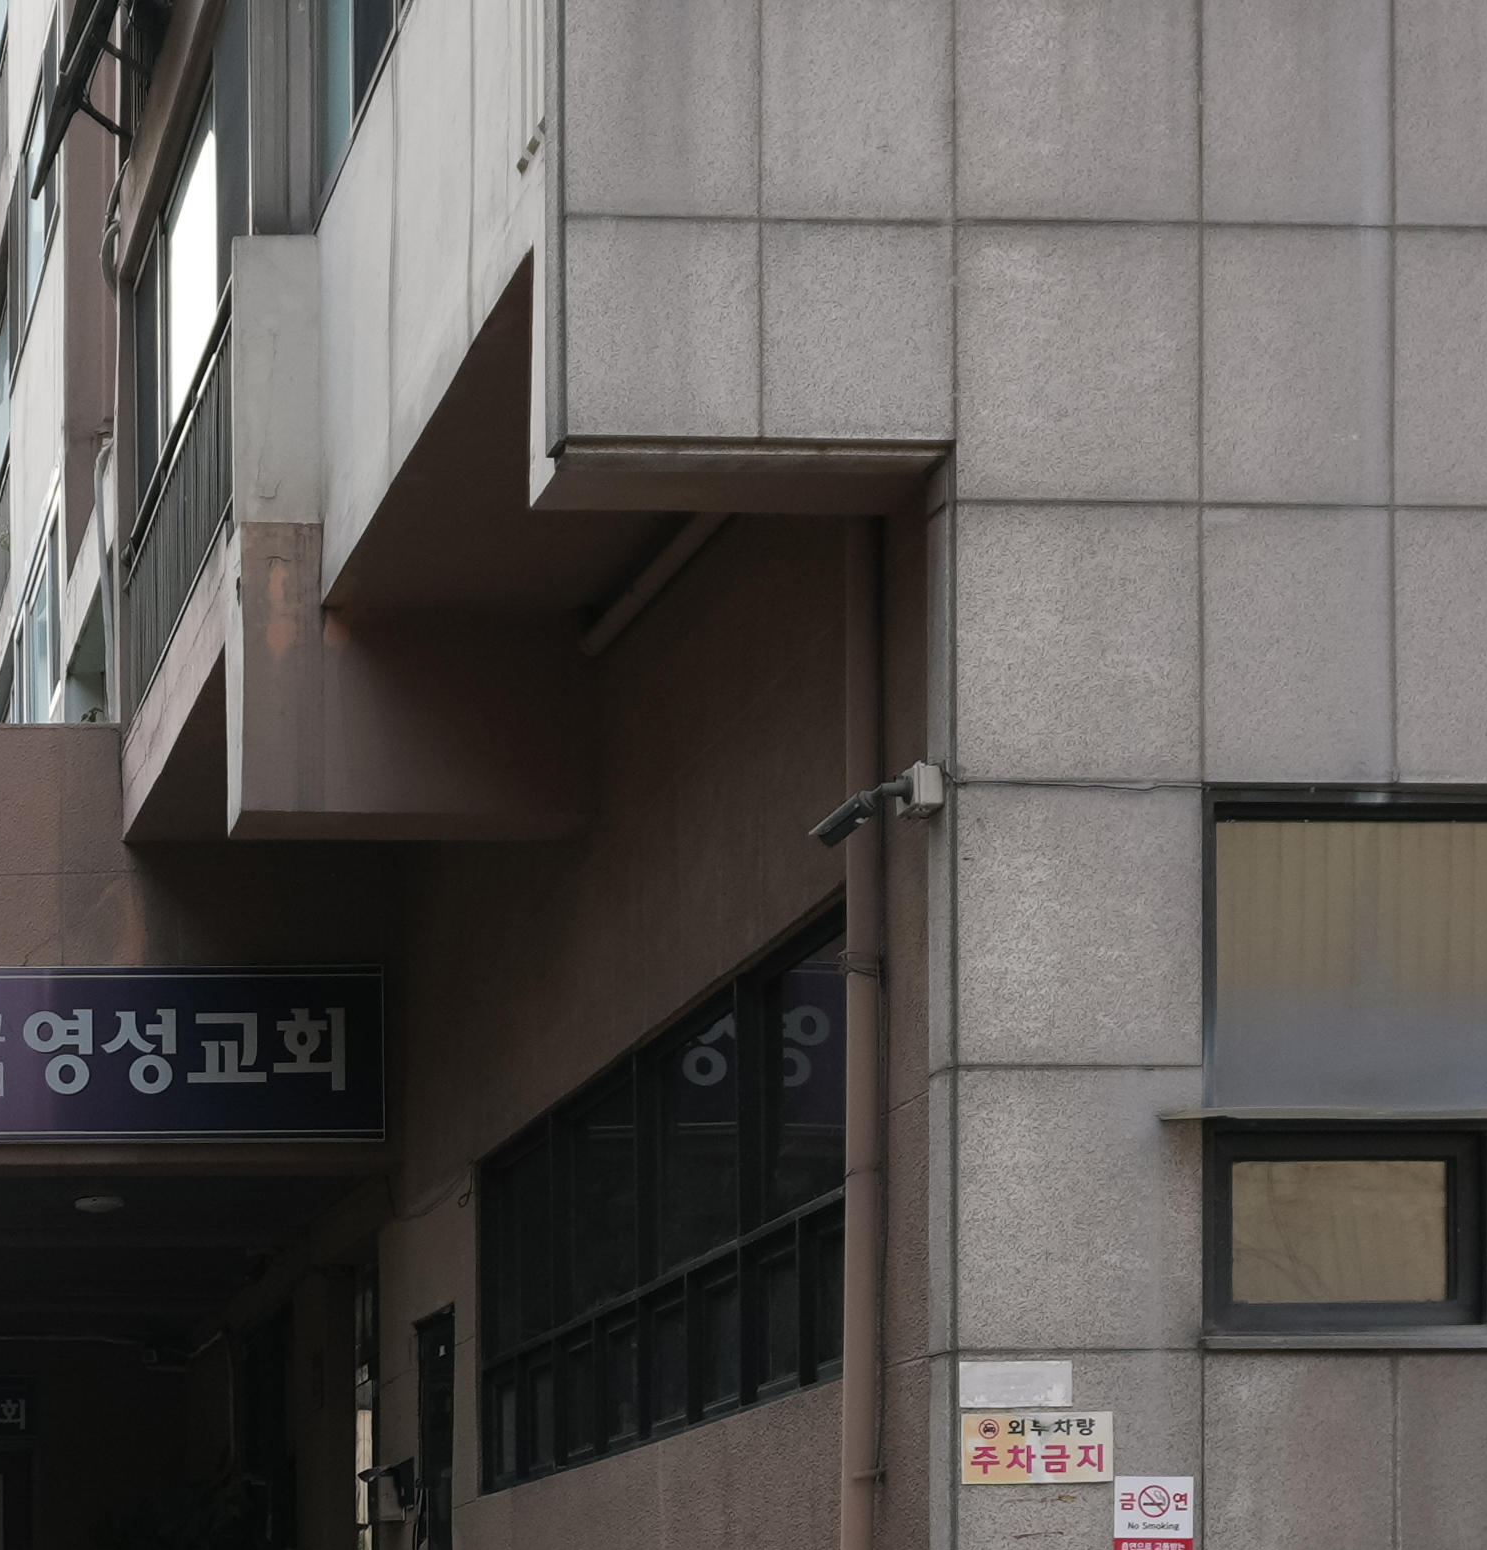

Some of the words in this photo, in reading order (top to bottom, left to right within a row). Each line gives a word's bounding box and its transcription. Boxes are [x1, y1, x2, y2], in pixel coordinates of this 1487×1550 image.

[22, 1006, 347, 1095] 영성교회
[970, 1443, 1104, 1475] 주차금지
[1128, 1521, 1139, 1530] No
[1142, 1521, 1180, 1531] Smoking
